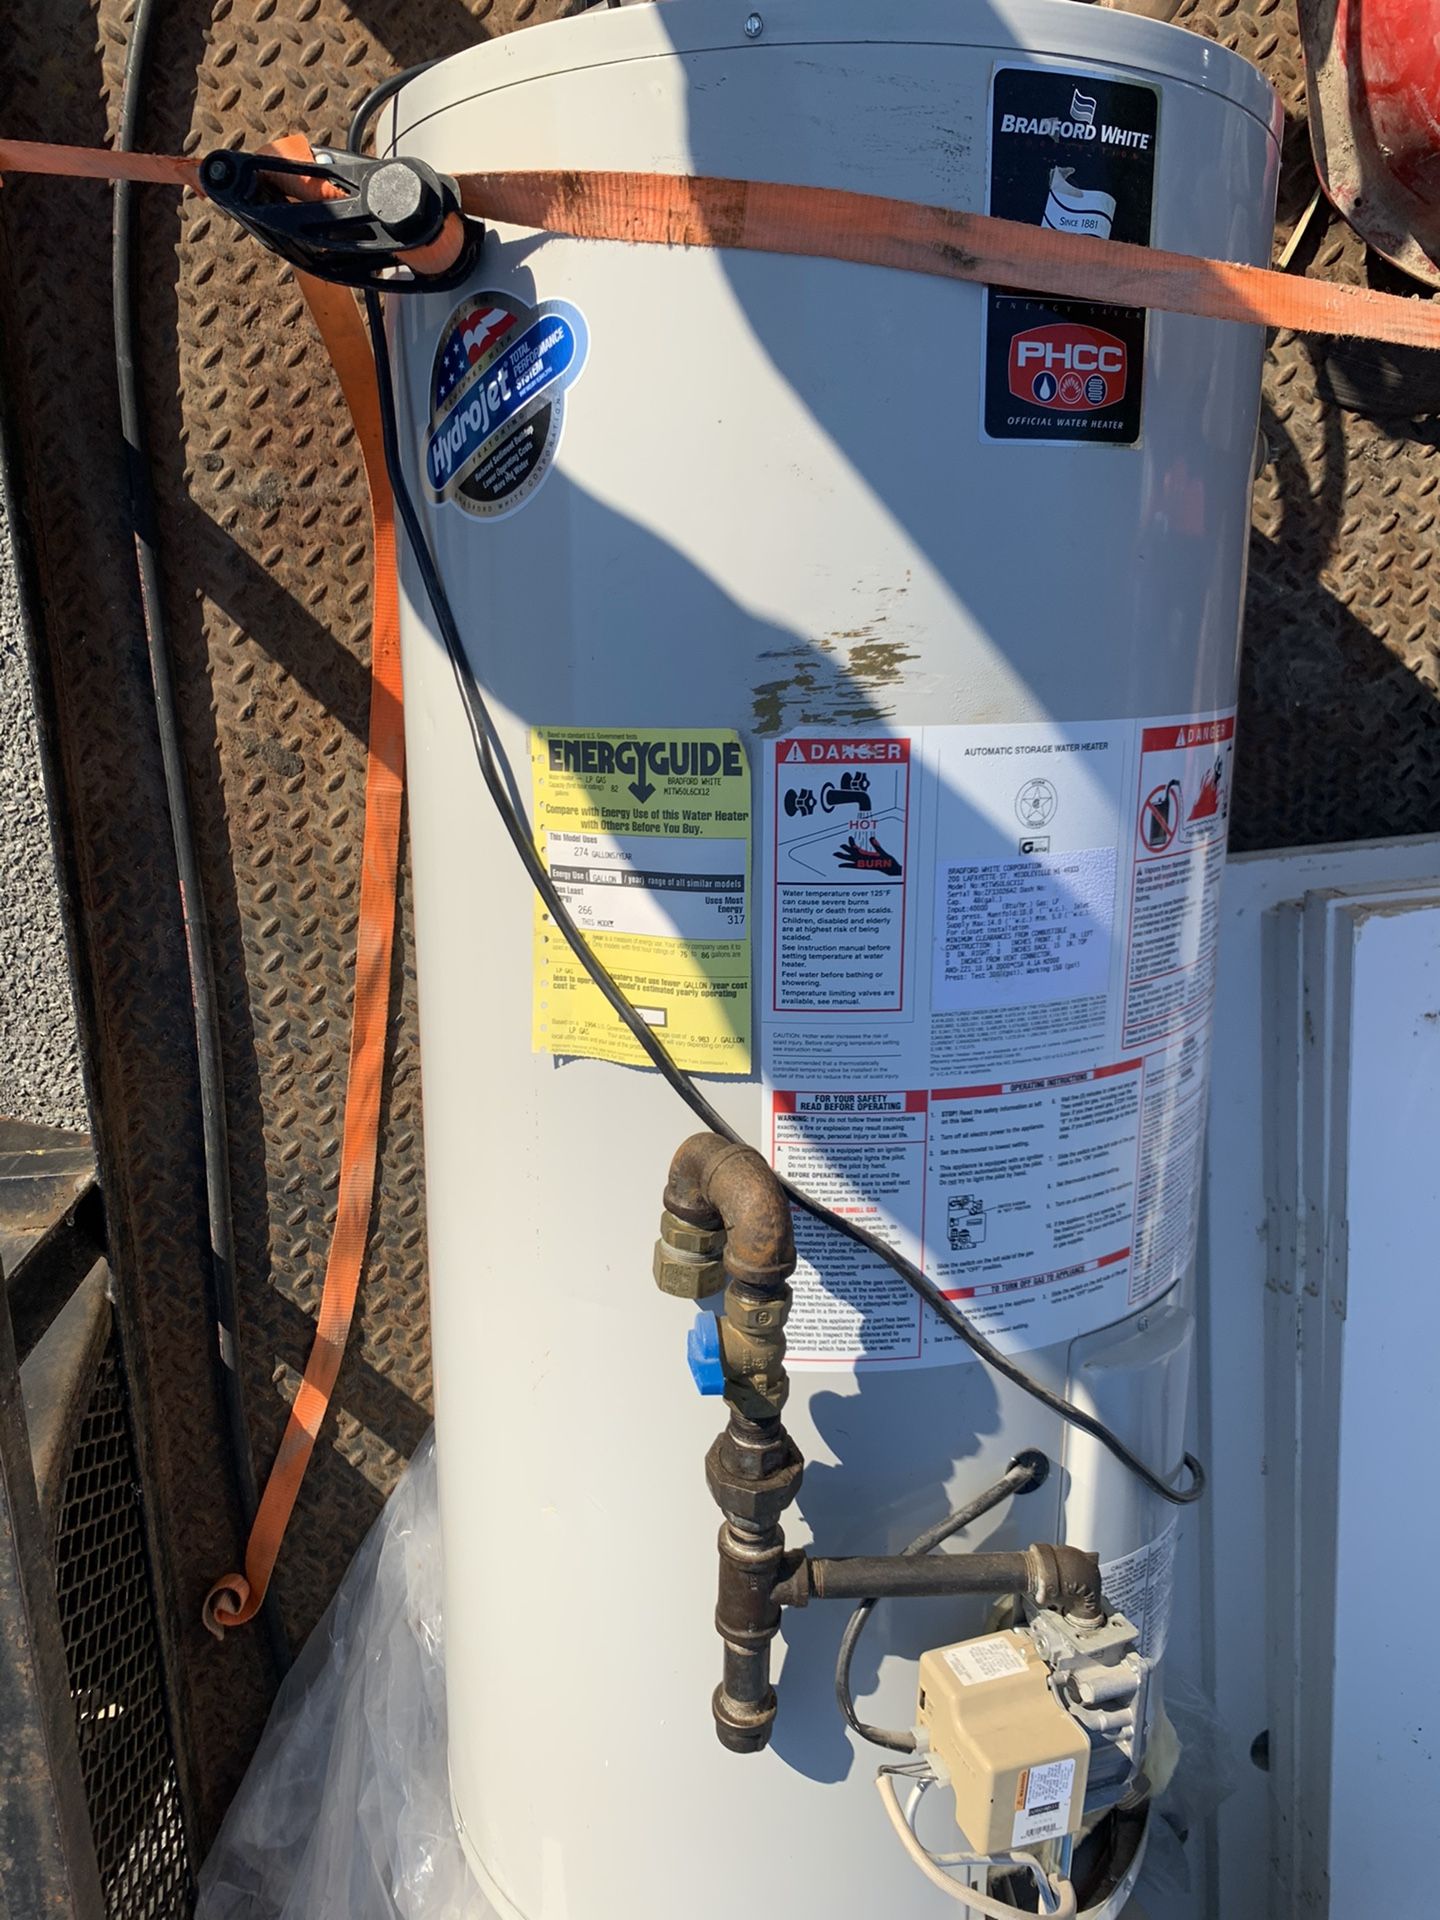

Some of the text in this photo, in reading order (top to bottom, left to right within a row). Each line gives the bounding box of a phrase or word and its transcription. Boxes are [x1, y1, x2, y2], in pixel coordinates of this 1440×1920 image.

[1001, 114, 1149, 149] BRADFORD WHITE
[1081, 219, 1098, 229] 1881
[509, 341, 530, 364] TOTAL
[513, 326, 564, 377] PERFORMANCE
[1017, 341, 1122, 372] PHCC
[516, 358, 544, 390] SYSTEM
[432, 367, 511, 476] Hydrojet
[1007, 417, 1123, 429] OFFICIAL WATER HEATER
[493, 441, 515, 464] Sediment
[483, 441, 533, 489] Lower Operating Costs
[811, 744, 901, 760] DANGER
[964, 742, 1108, 756] AUTOMATIC STORAGE WATER HEATER
[549, 740, 742, 776] ENERGYGUIDE
[668, 777, 698, 785] BRADFORD
[546, 804, 749, 821] Compare with Energy Use of this Water Heater
[581, 819, 703, 835] with Others Before You Buy.
[850, 820, 877, 830] HOT
[550, 833, 597, 844] This Model Uses
[574, 847, 632, 860] 274 GALLONS/YEAR
[857, 859, 892, 868] BURN
[982, 865, 1000, 873] WHITE
[553, 869, 571, 880] Energy
[572, 871, 584, 879] Use
[592, 874, 617, 883] GALLON
[648, 878, 666, 887] range
[668, 878, 675, 886] of
[676, 878, 685, 887] all
[687, 879, 712, 888] similar
[714, 880, 741, 889] models
[578, 905, 592, 914] 266
[718, 905, 743, 914] Energy
[727, 915, 745, 925] 317
[711, 951, 730, 959] gallons
[643, 984, 736, 999] estimated yearly operating
[684, 981, 707, 989] GALLON
[732, 982, 747, 990] cost
[782, 989, 827, 997] Temperature
[1010, 1073, 1087, 1091] OPERATING INSTRUCTIONS
[801, 1102, 900, 1111] READ BEFORE OPERATING
[1002, 1283, 1017, 1291] TURN
[1020, 1280, 1030, 1288] OFF
[1034, 1277, 1044, 1285] GAS
[1056, 1265, 1084, 1278] APPLIANCE
